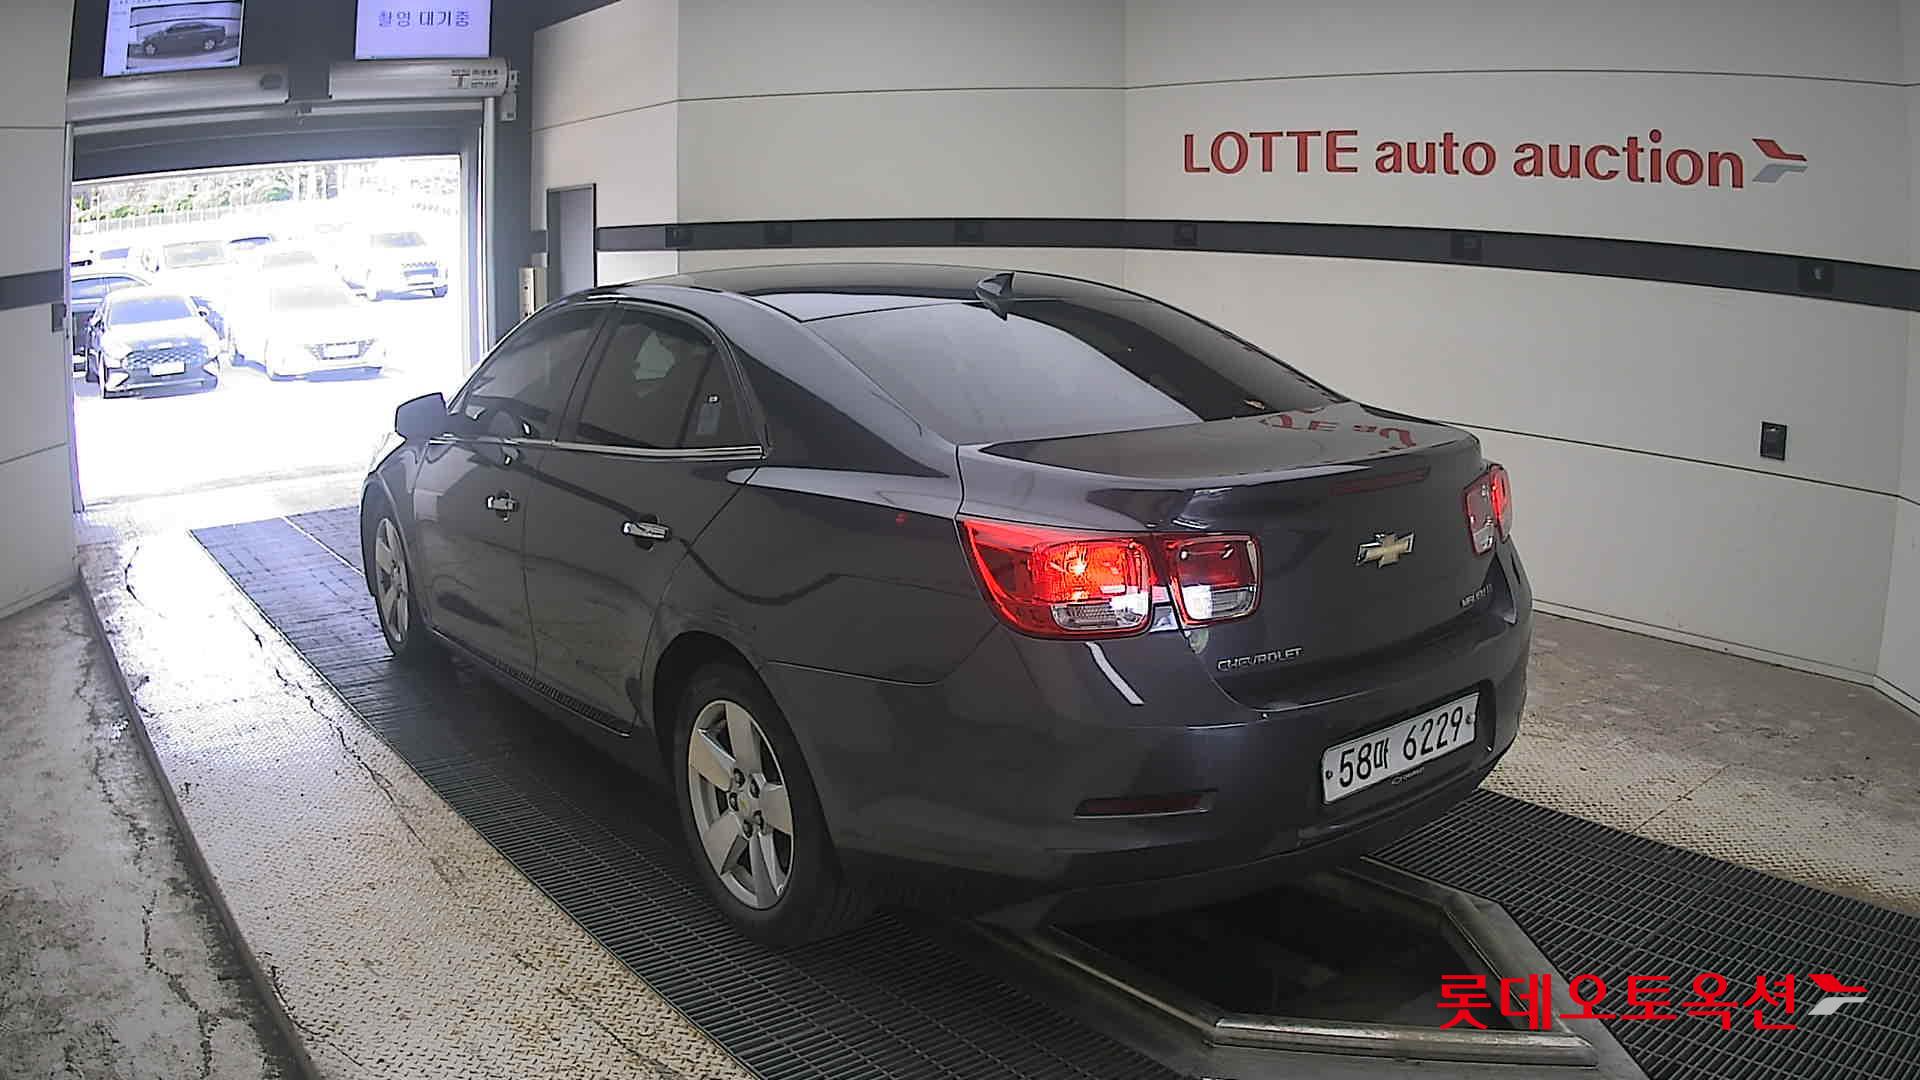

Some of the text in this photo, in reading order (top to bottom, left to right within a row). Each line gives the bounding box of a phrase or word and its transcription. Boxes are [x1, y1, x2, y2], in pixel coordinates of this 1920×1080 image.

[419, 10, 470, 27] 대기중
[1184, 129, 1744, 189] LOTTE auto auction
[1217, 647, 1303, 672] CHEVROLET
[1339, 706, 1463, 787] 58마 6229
